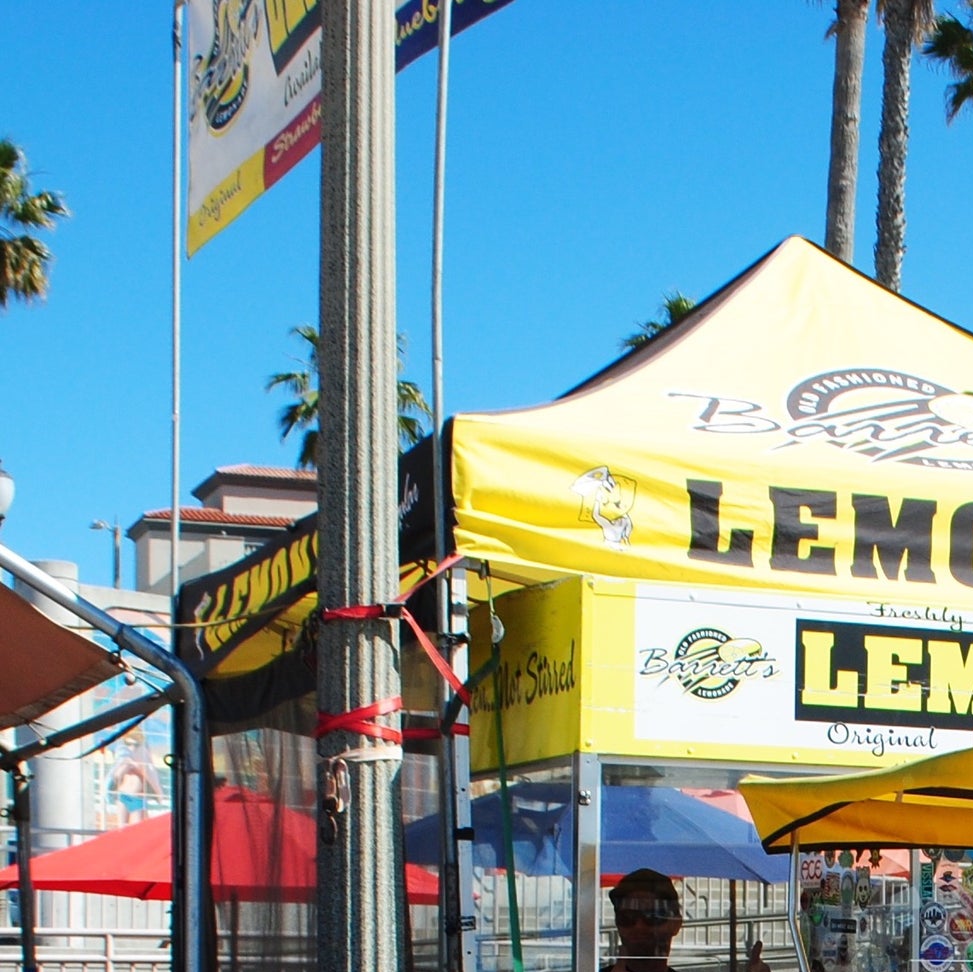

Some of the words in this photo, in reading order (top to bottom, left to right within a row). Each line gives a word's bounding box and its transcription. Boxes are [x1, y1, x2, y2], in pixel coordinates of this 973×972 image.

[797, 392, 821, 415] OLD
[811, 371, 936, 396] FASHIONED
[866, 600, 963, 633] Freshly
[525, 639, 576, 705] Stirred
[639, 647, 781, 678] Barrett's
[697, 682, 735, 699] LEMONADE
[827, 721, 938, 757] Original
